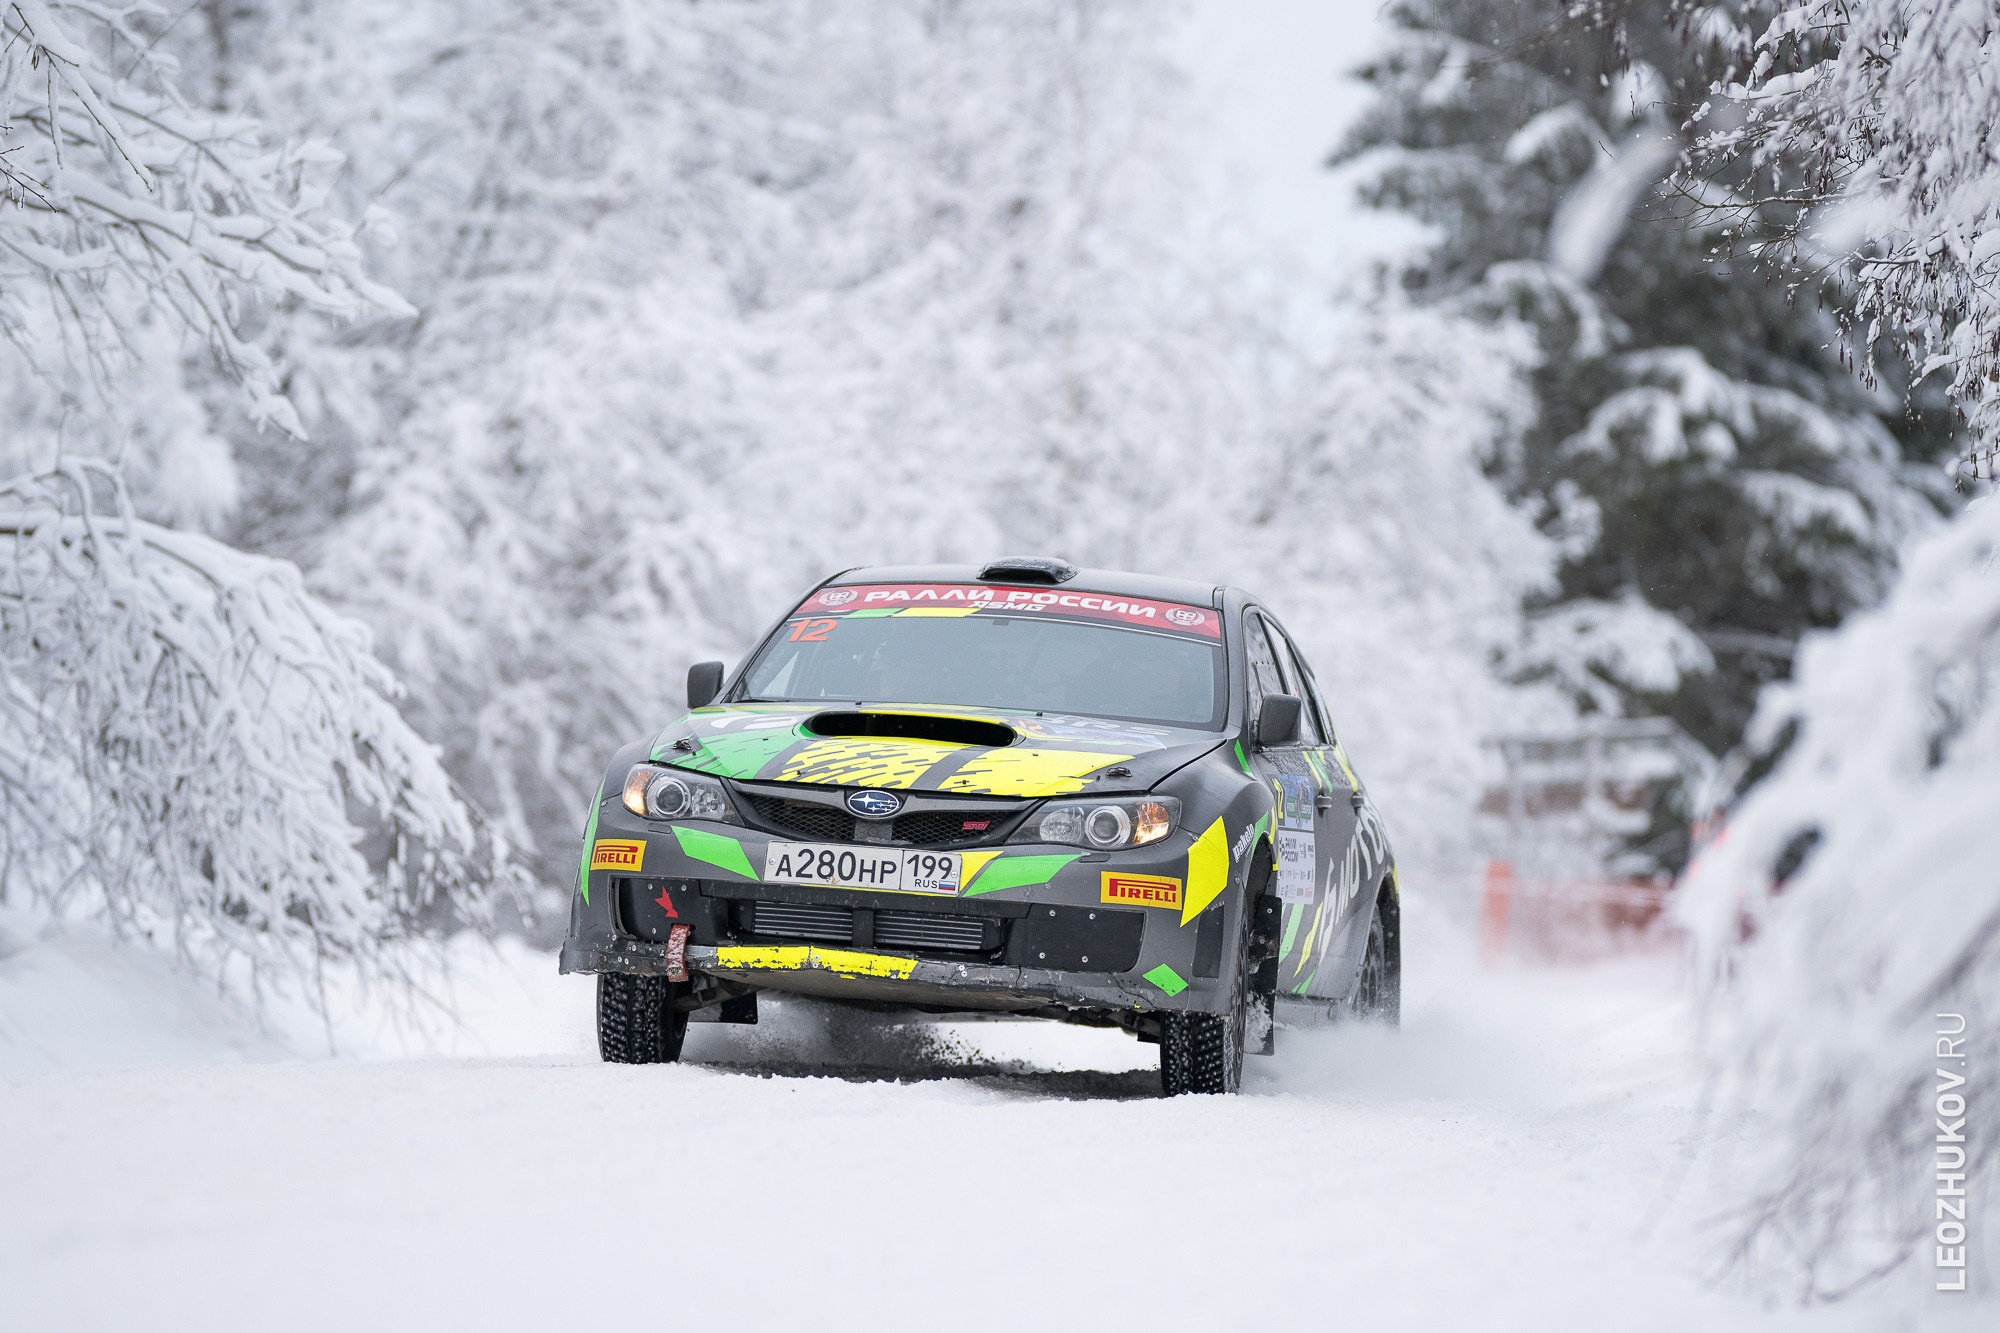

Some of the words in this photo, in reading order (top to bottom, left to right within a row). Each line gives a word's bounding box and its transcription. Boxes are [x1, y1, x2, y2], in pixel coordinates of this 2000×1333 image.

[863, 588, 994, 604] РАЛЛИ
[1006, 590, 1157, 618] РОССИИ
[788, 618, 839, 643] 12
[593, 844, 639, 865] PIRELLI
[1232, 823, 1255, 864] pakelo
[906, 853, 954, 881] 199
[914, 878, 938, 890] RUS
[1108, 877, 1177, 903] PIRELLI
